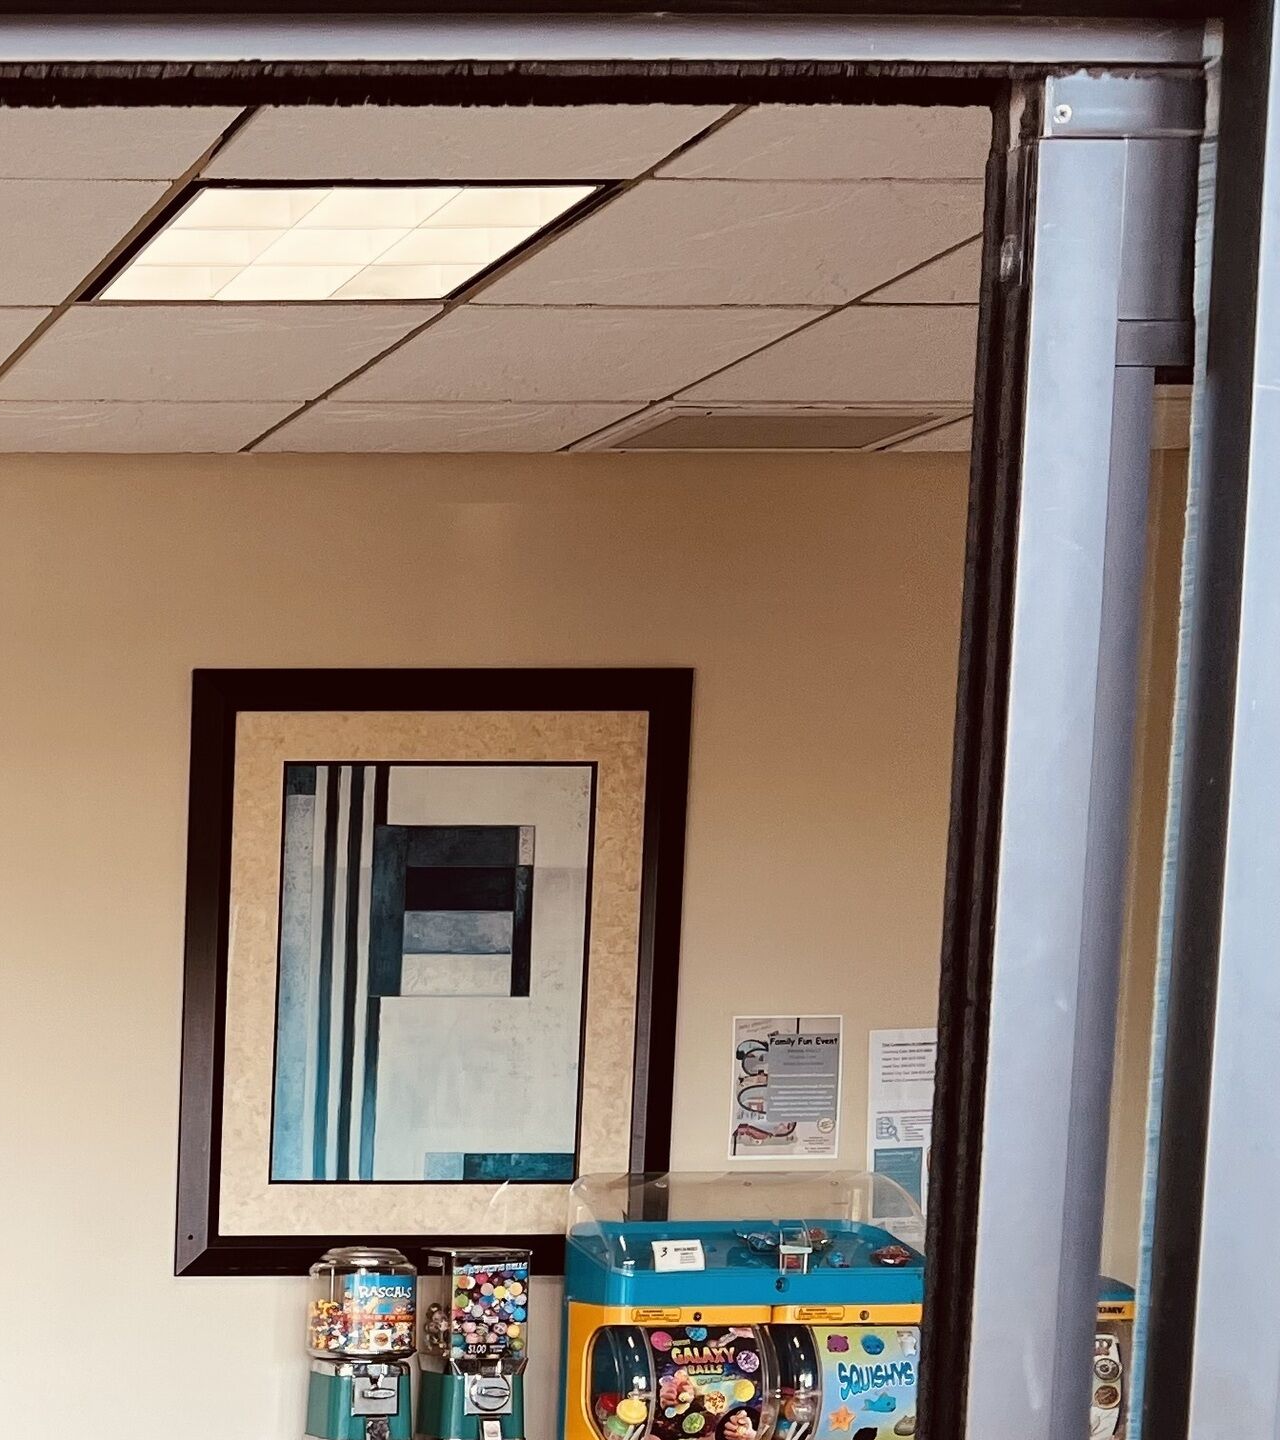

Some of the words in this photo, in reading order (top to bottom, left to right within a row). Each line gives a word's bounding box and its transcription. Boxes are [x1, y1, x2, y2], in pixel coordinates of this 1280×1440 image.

[770, 1038, 796, 1046] Family
[798, 1037, 813, 1045] Fun
[816, 1037, 838, 1045] Event
[358, 1286, 413, 1298] RASCALS
[671, 1346, 735, 1365] GALAXY
[688, 1364, 723, 1375] BALLS
[837, 1361, 915, 1400] SQUISHYS
